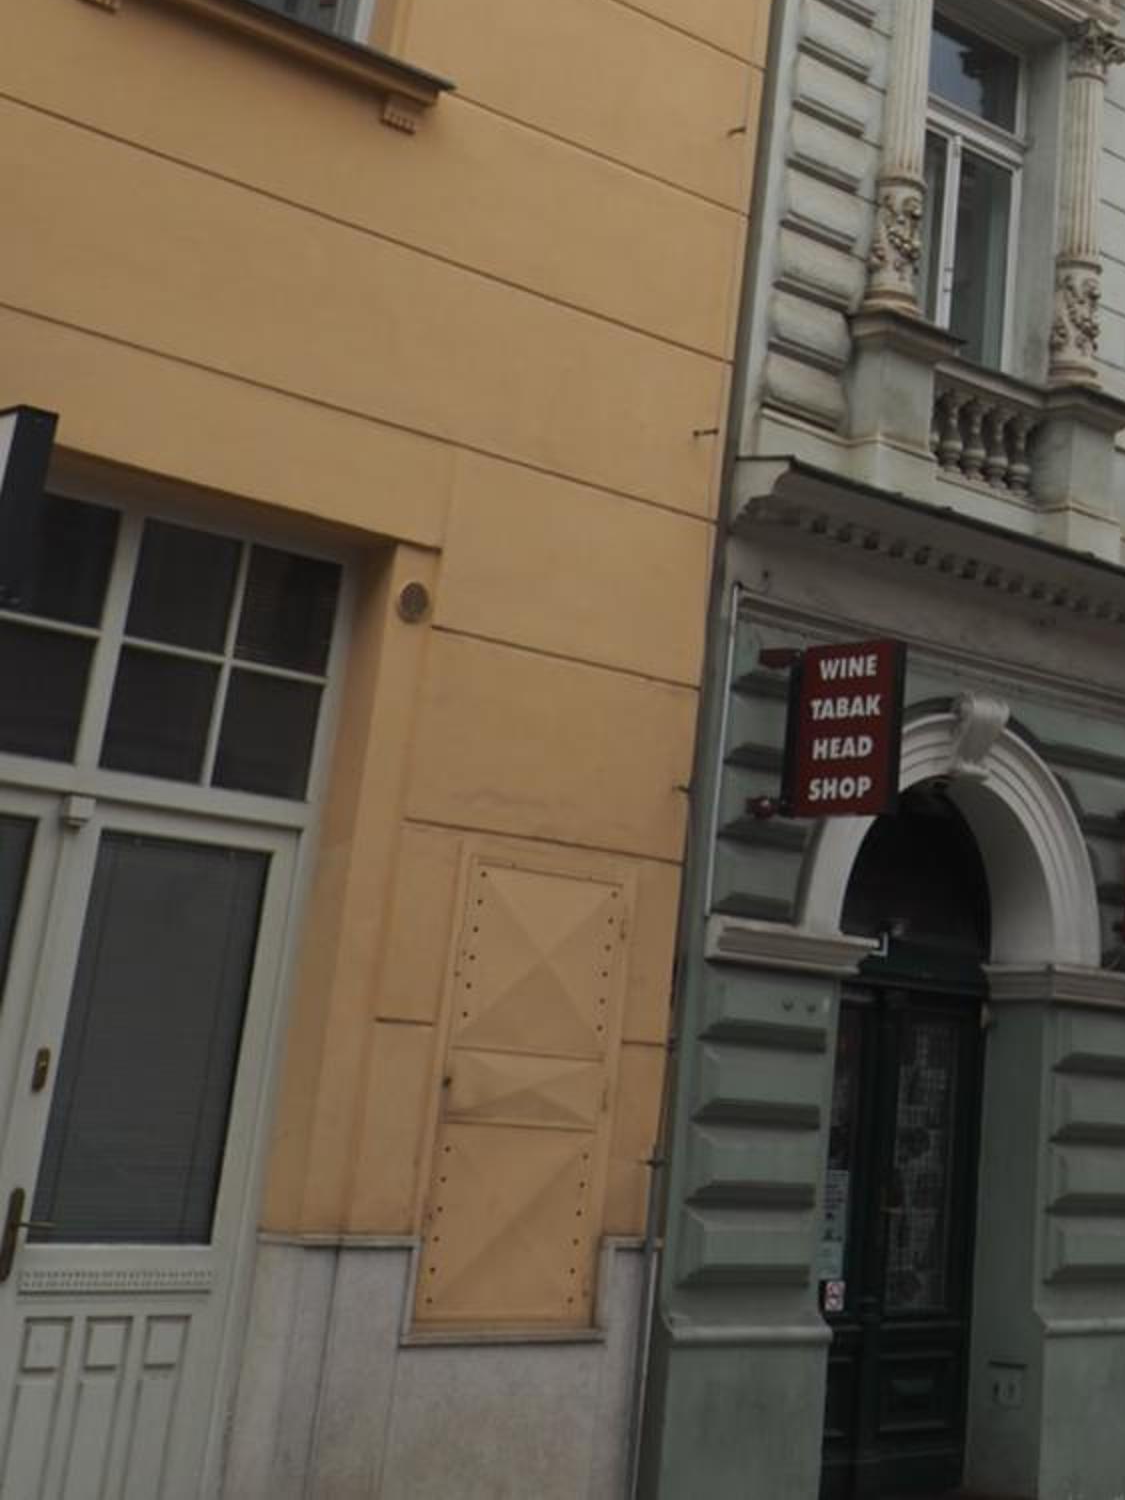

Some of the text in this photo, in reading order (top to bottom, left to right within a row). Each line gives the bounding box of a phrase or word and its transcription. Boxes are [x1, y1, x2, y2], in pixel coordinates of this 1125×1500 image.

[819, 654, 878, 681] WINE
[810, 694, 881, 720] TABAK
[812, 736, 873, 760] HEAD
[808, 776, 871, 801] SHOP
